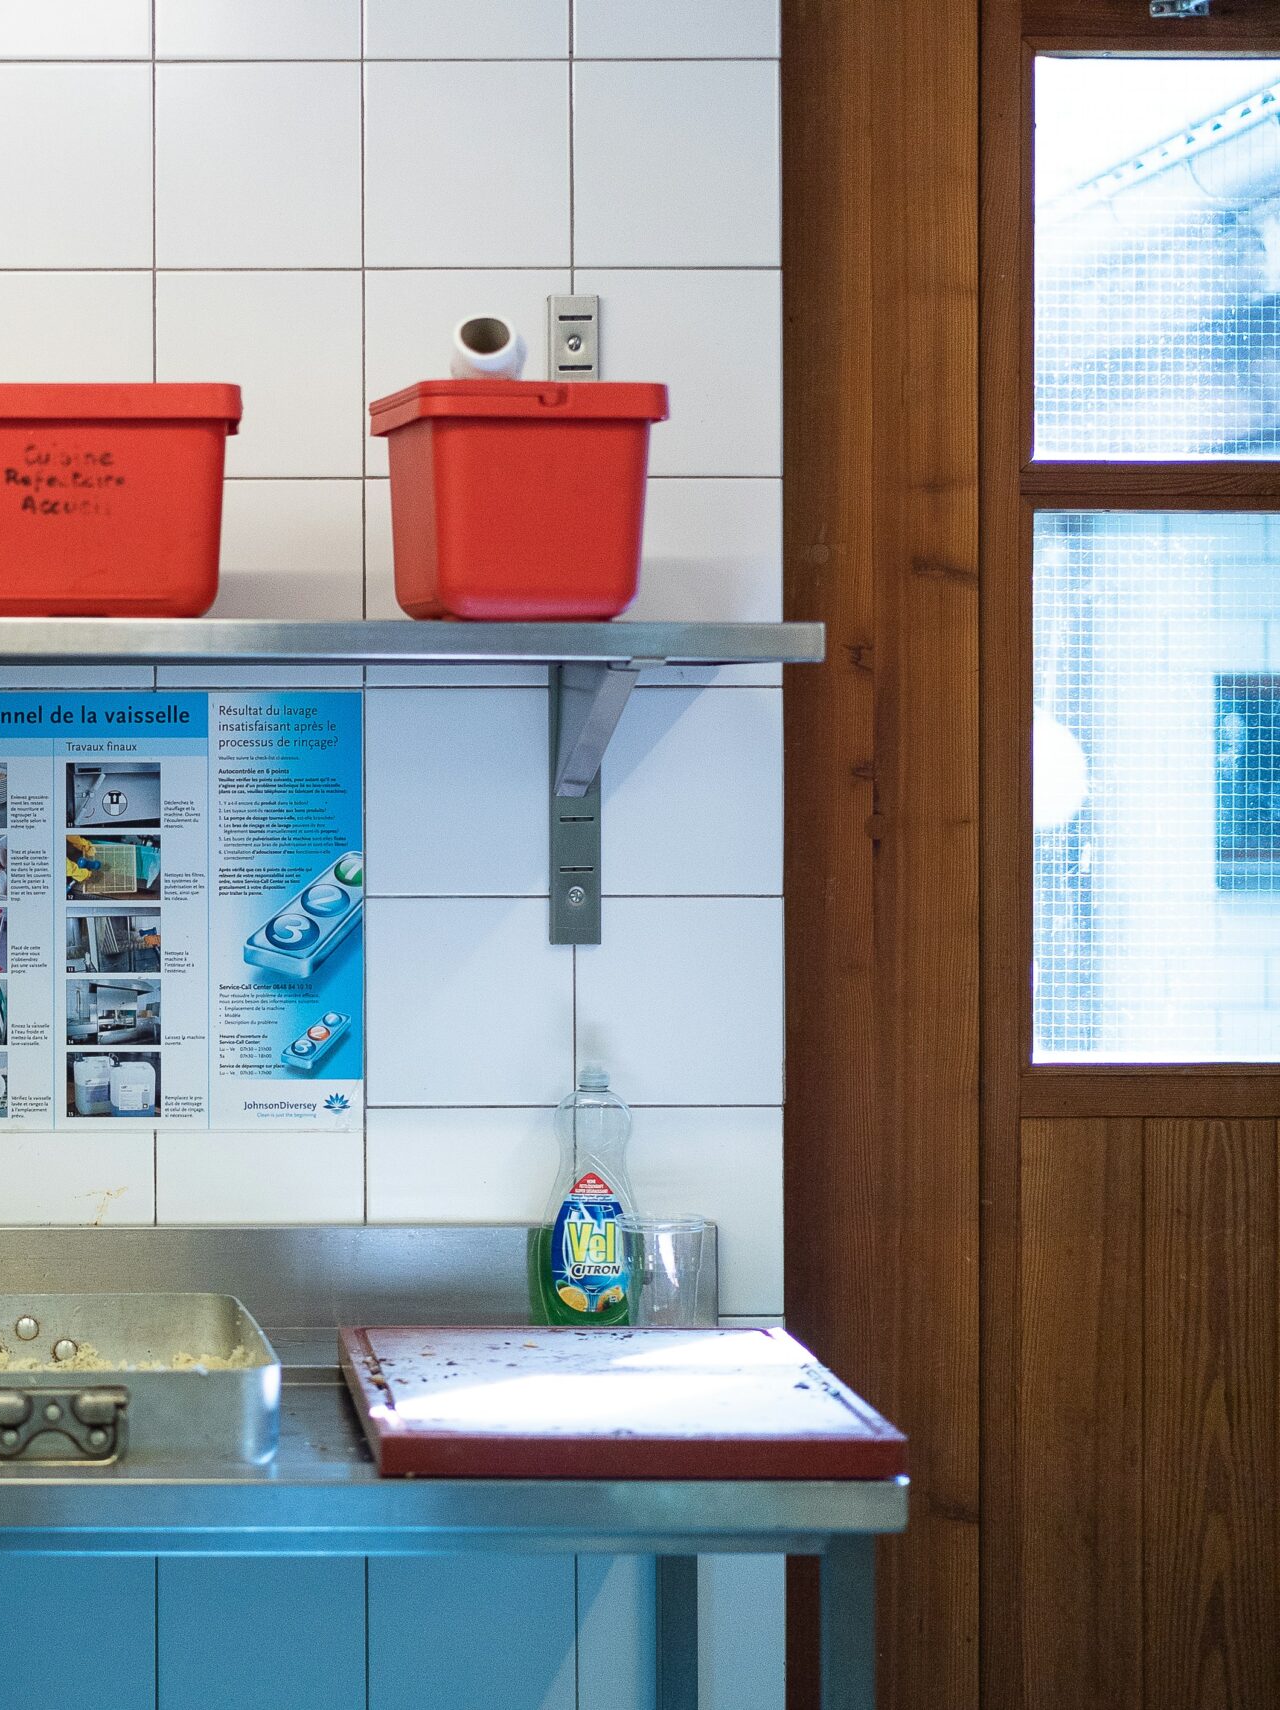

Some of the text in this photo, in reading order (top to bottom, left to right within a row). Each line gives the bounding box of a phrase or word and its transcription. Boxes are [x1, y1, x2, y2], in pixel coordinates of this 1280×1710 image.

[50, 705, 74, 724] de
[81, 704, 97, 724] la
[104, 704, 191, 724] vaisselle
[218, 704, 318, 720] Résultat du lavage
[218, 720, 336, 736] insatisfaisant après le
[65, 741, 137, 751] Travaux finaux
[218, 736, 339, 752] processus de rinçage?
[244, 1101, 317, 1112] JohnsonDiversey
[568, 1221, 616, 1263] Vel
[572, 1264, 620, 1277] CITRON
